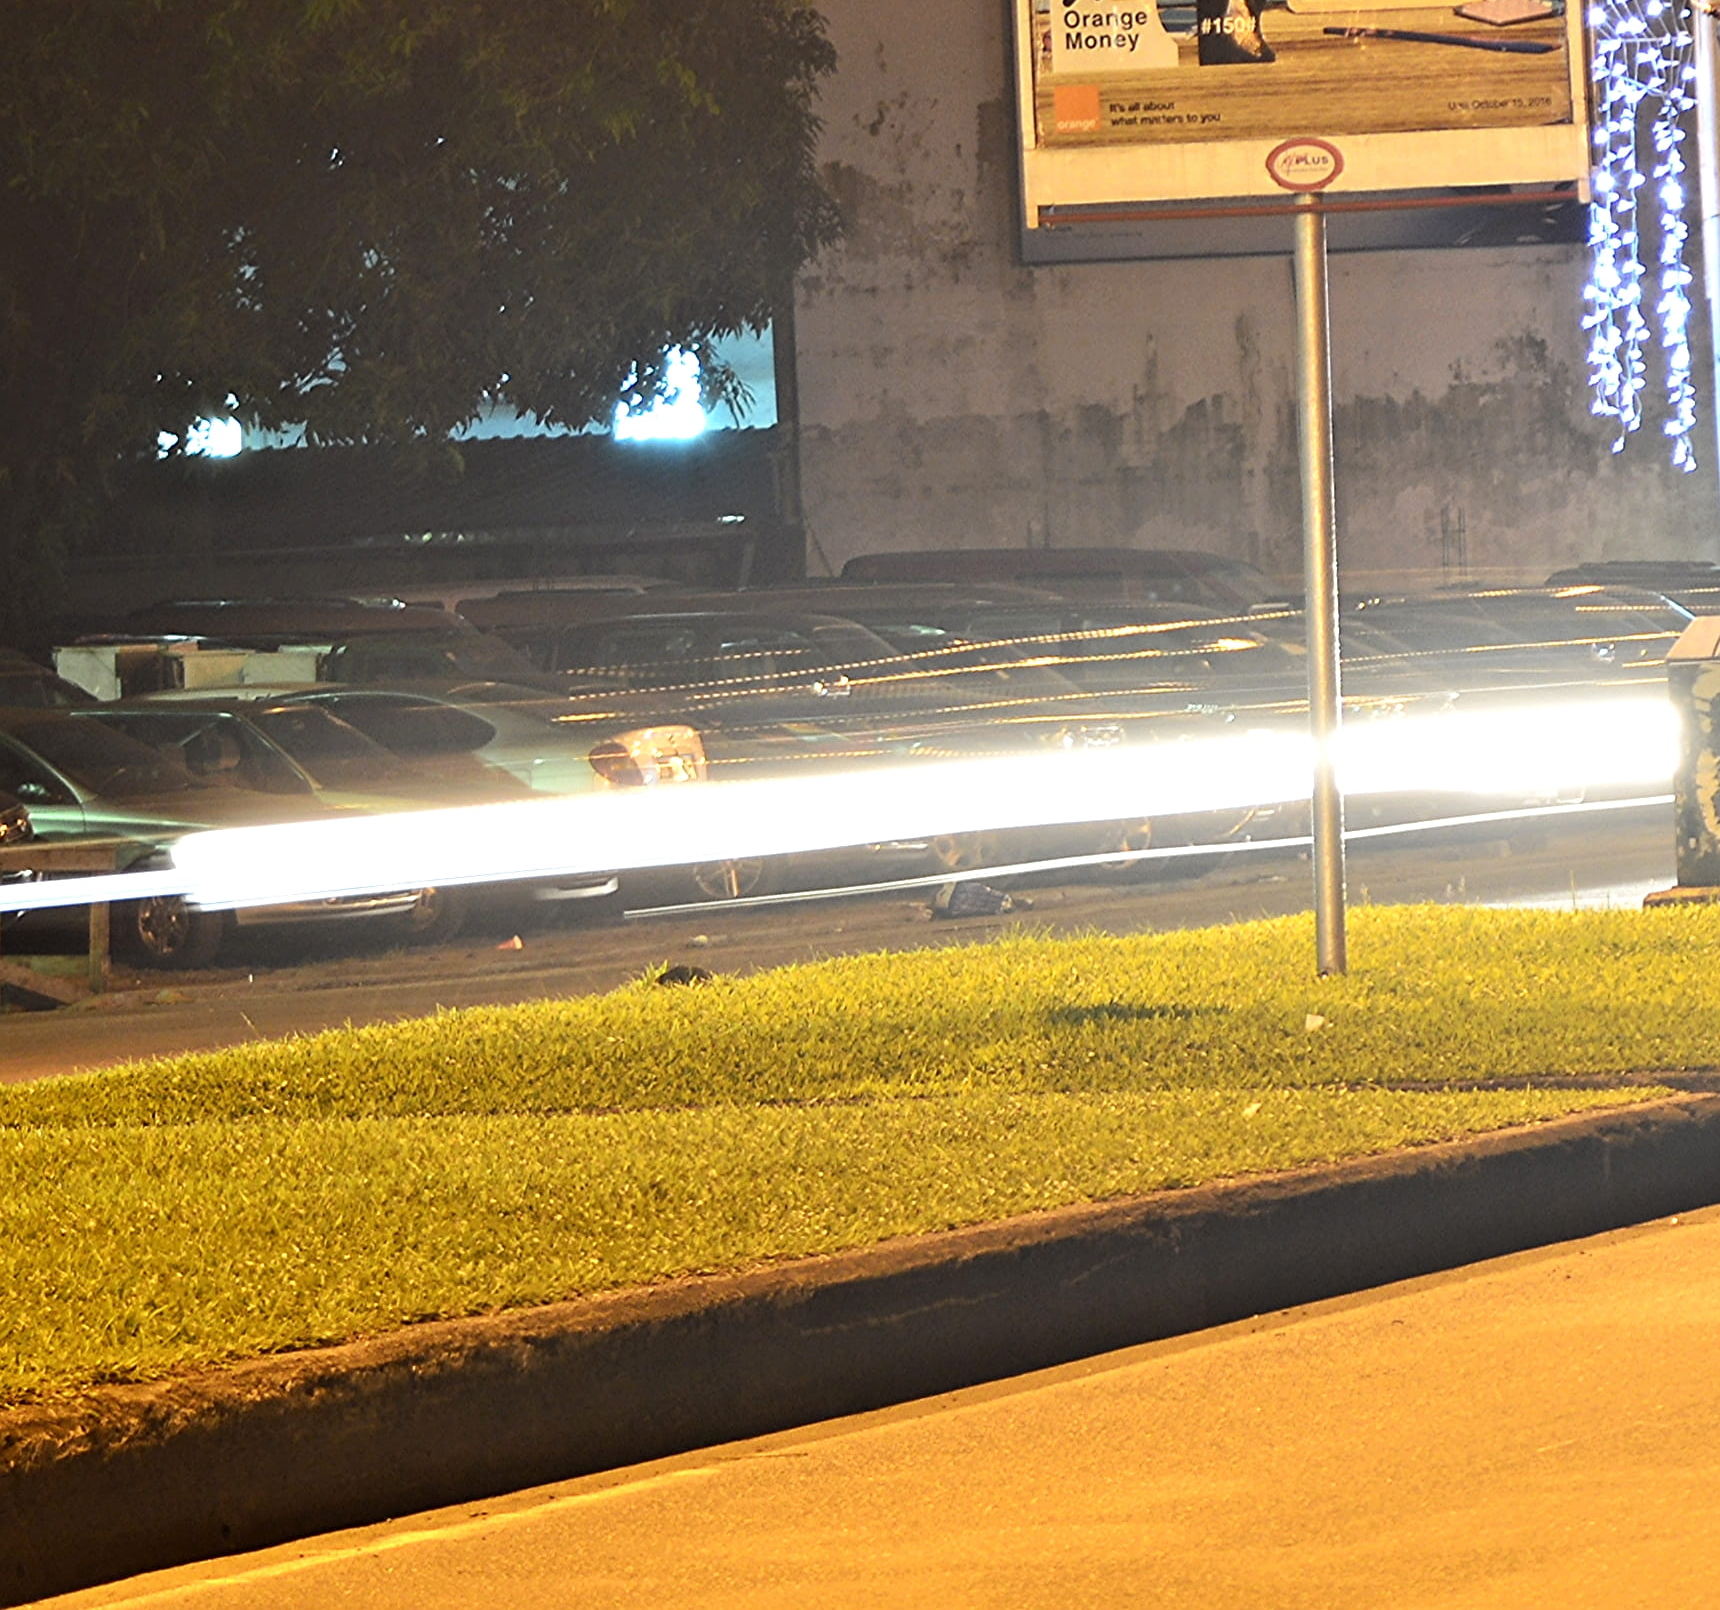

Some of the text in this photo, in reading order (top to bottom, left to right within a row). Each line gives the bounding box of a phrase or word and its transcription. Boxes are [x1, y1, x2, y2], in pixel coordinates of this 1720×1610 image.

[1064, 10, 1148, 31] Orange
[1201, 17, 1256, 34] #150#
[1066, 32, 1140, 52] Money
[1143, 101, 1175, 111] about
[1187, 114, 1199, 123] to
[1201, 113, 1221, 124] you
